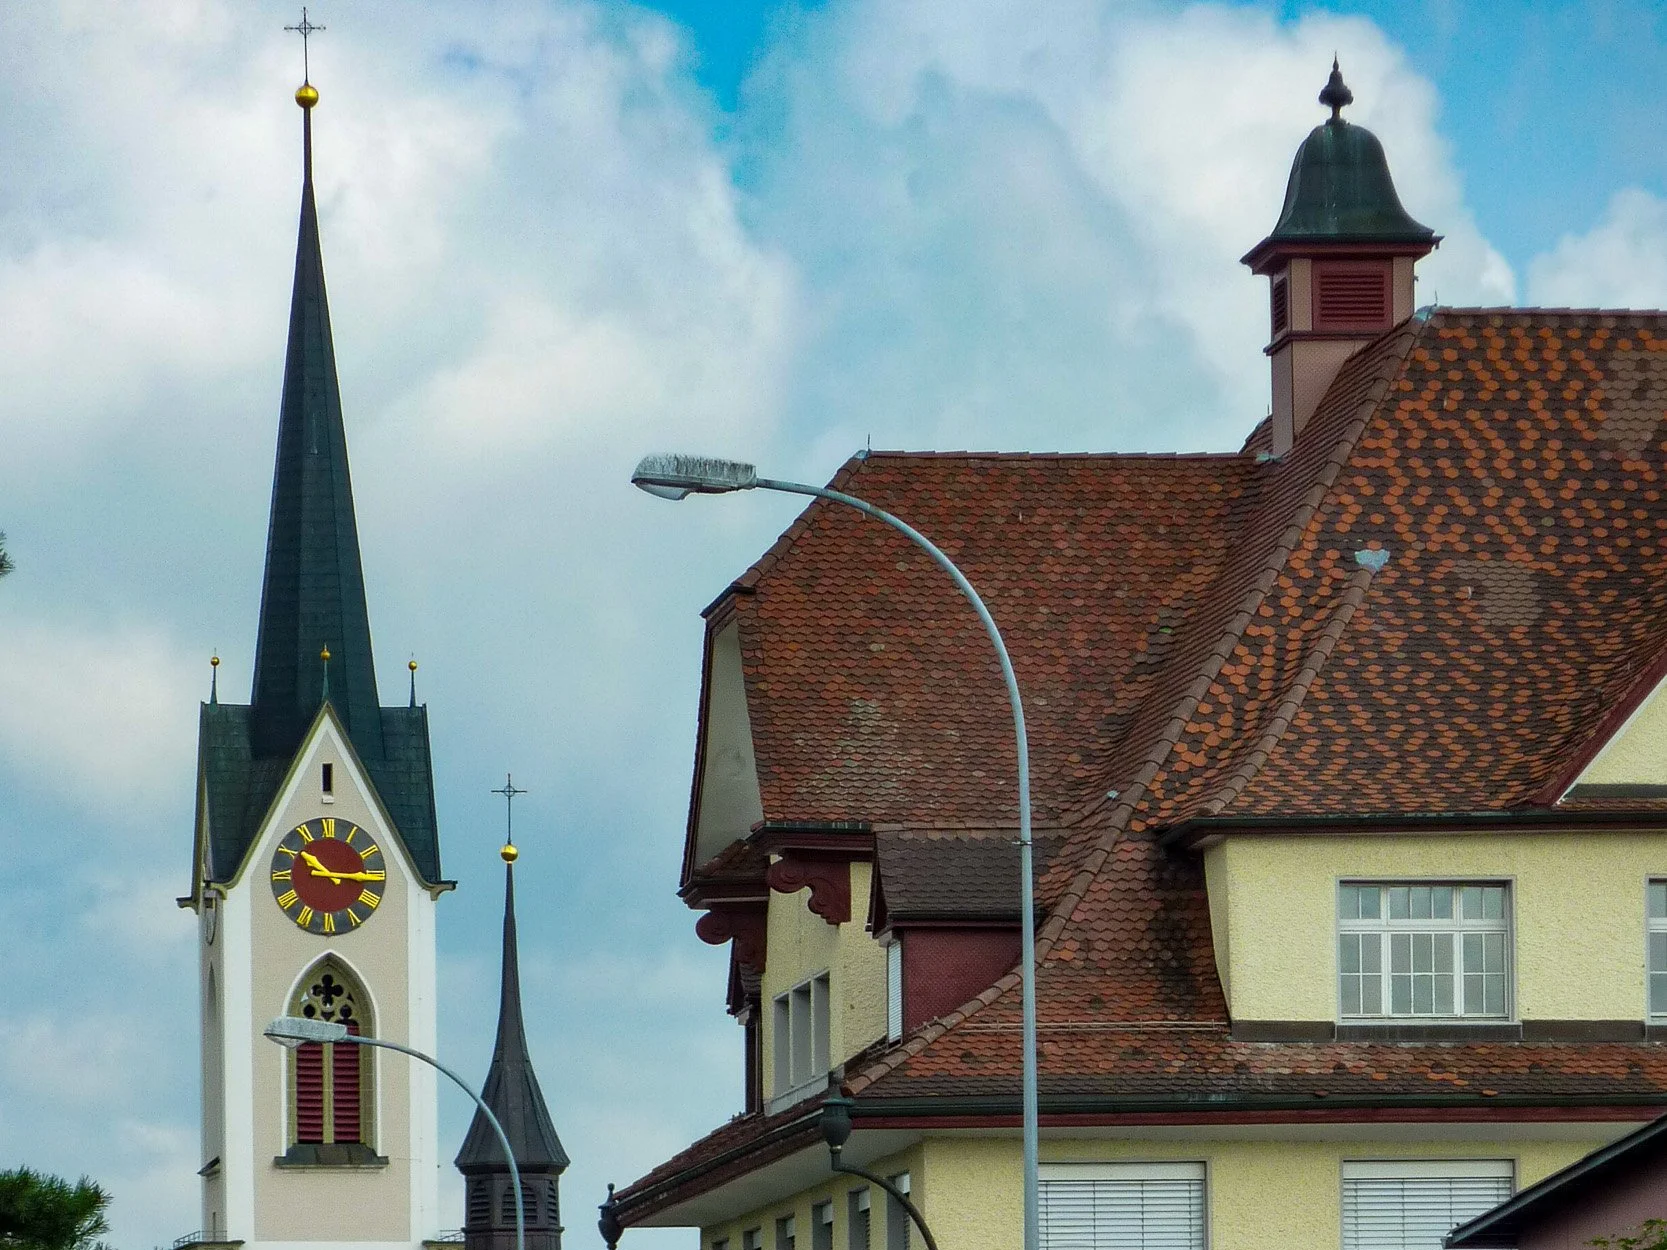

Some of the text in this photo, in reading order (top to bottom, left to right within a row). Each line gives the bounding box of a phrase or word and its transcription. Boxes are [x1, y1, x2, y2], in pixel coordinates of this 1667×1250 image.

[296, 824, 314, 844] XI
[322, 818, 335, 838] XII
[346, 826, 358, 843] I
[278, 844, 298, 859] X
[360, 844, 379, 859] II
[347, 908, 361, 926] V
